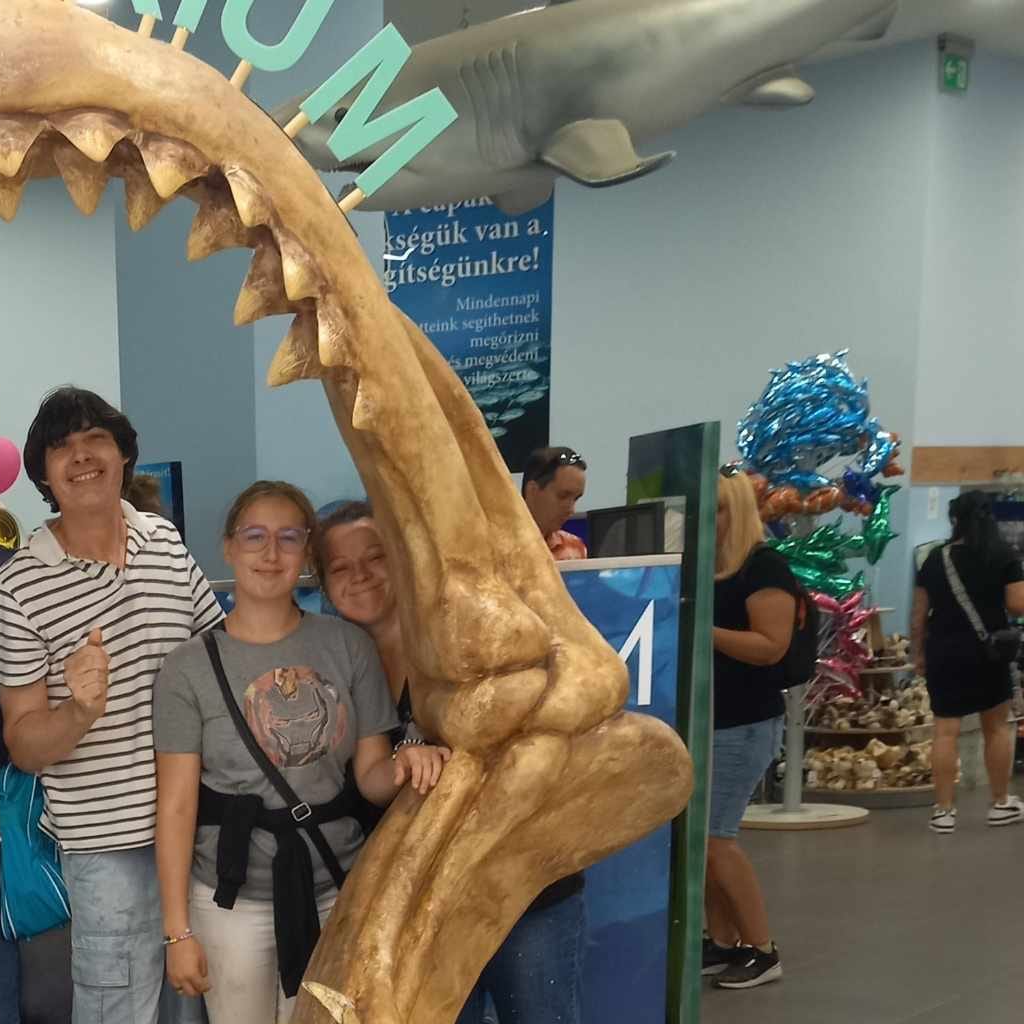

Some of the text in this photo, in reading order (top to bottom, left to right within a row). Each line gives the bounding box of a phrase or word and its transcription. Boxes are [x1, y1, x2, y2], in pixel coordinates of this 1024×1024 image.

[385, 220, 468, 256] kségük
[474, 219, 520, 242] van
[384, 246, 540, 293] gítségünkre!
[456, 290, 540, 312] Mindennapi
[462, 308, 540, 332] segíthetnek
